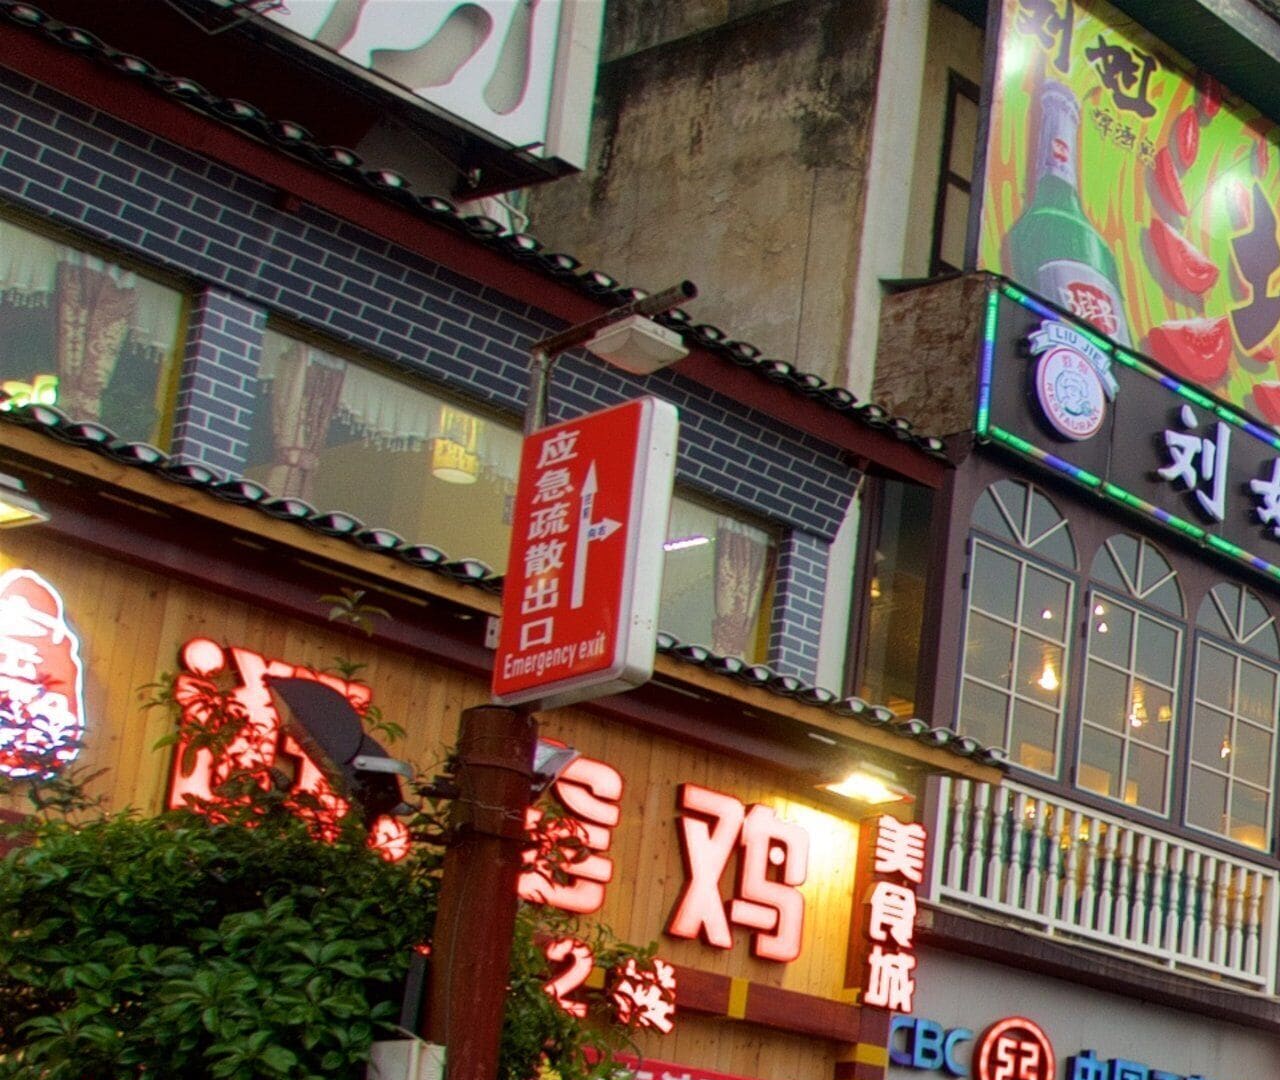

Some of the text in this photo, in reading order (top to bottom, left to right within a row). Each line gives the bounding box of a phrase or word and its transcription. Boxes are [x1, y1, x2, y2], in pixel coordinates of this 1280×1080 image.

[1056, 326, 1103, 363] LIU JIE
[1046, 382, 1101, 433] RESTAURANT
[518, 429, 581, 651] 应急疏散出口
[503, 630, 606, 680] Emergency exit
[863, 813, 928, 1014] 美食城
